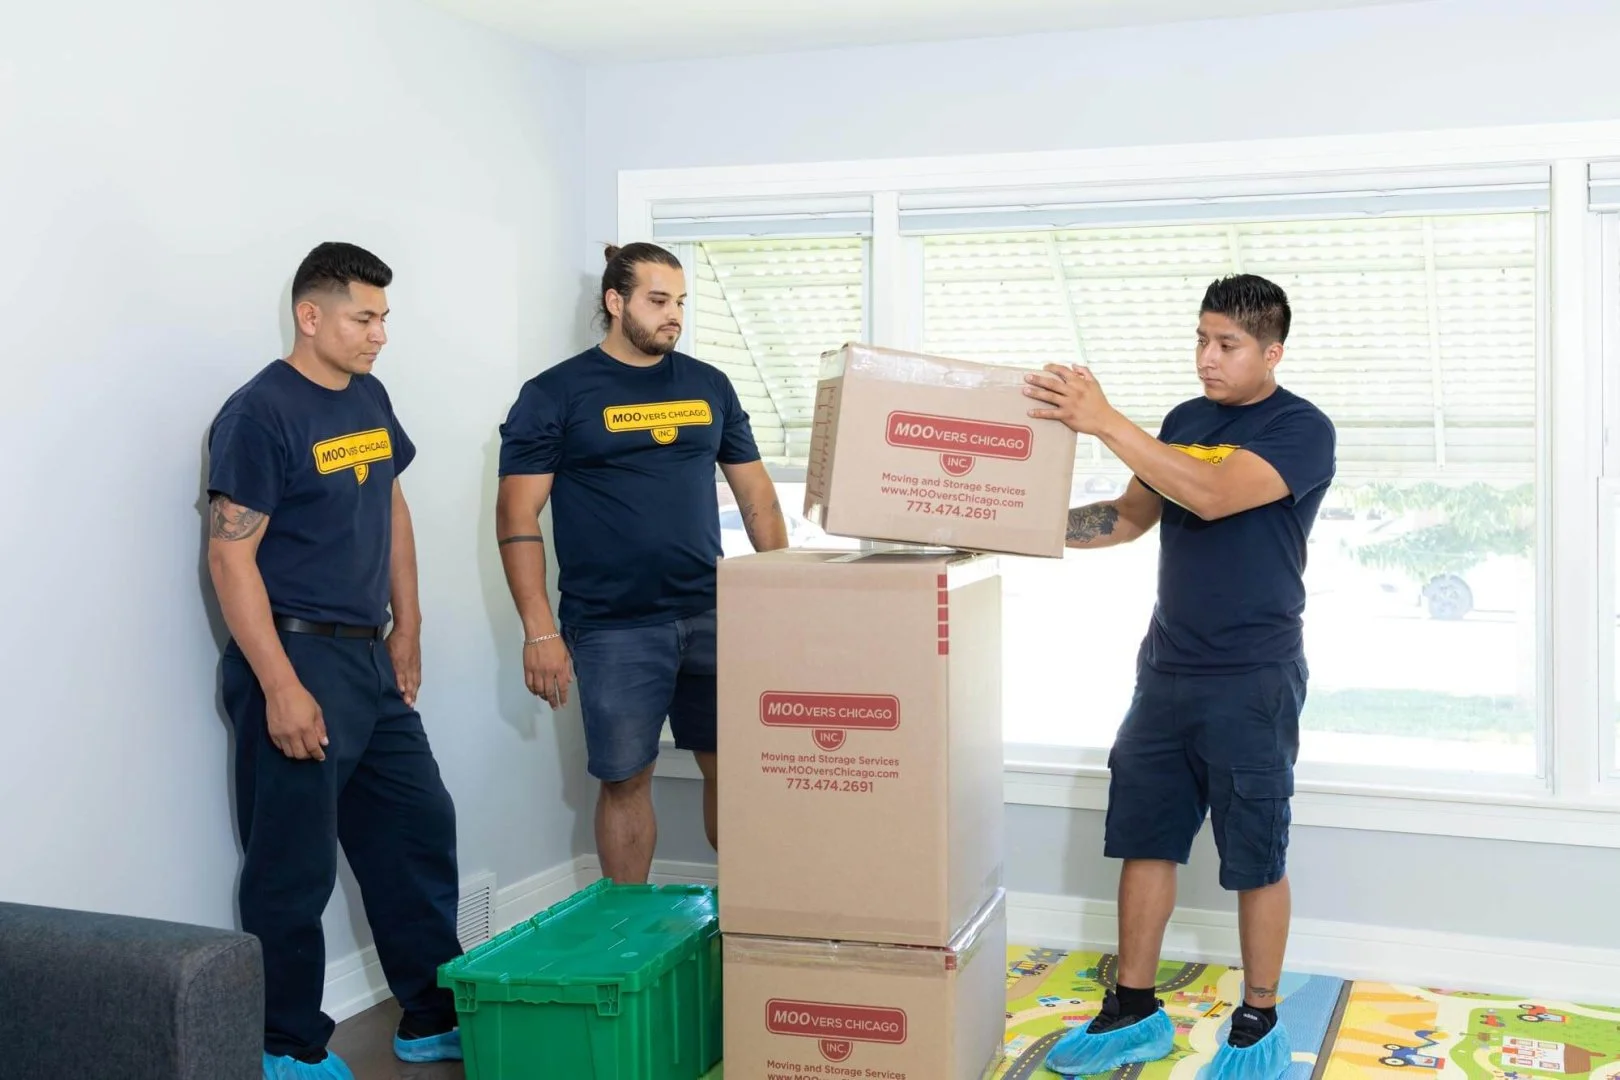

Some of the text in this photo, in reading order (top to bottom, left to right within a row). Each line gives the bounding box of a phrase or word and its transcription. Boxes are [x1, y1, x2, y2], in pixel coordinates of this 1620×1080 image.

[612, 409, 707, 423] MOOVERS CHICAGO
[894, 422, 1025, 450] MOOVERS CHICAGO
[359, 440, 389, 454] CHICAGO
[947, 456, 969, 469] INC.
[882, 472, 1026, 496] Moving and Storage Services
[881, 485, 1024, 509] www.MOOversChicago.com
[906, 500, 997, 521] 773.474.2691
[768, 702, 892, 720] MOOVERS CHICAGO
[820, 732, 840, 742] INC.
[761, 752, 900, 766] Moving and Storage Services
[761, 765, 899, 779] www.MOOversChicago.com
[786, 778, 874, 793] 773.474.2691
[773, 1010, 899, 1033] MOOVERS CHICAGO
[826, 1042, 847, 1053] INC.
[767, 1060, 801, 1073] Moving
[803, 1064, 821, 1073] and
[824, 1065, 862, 1078] Storage
[865, 1068, 906, 1080] Services
